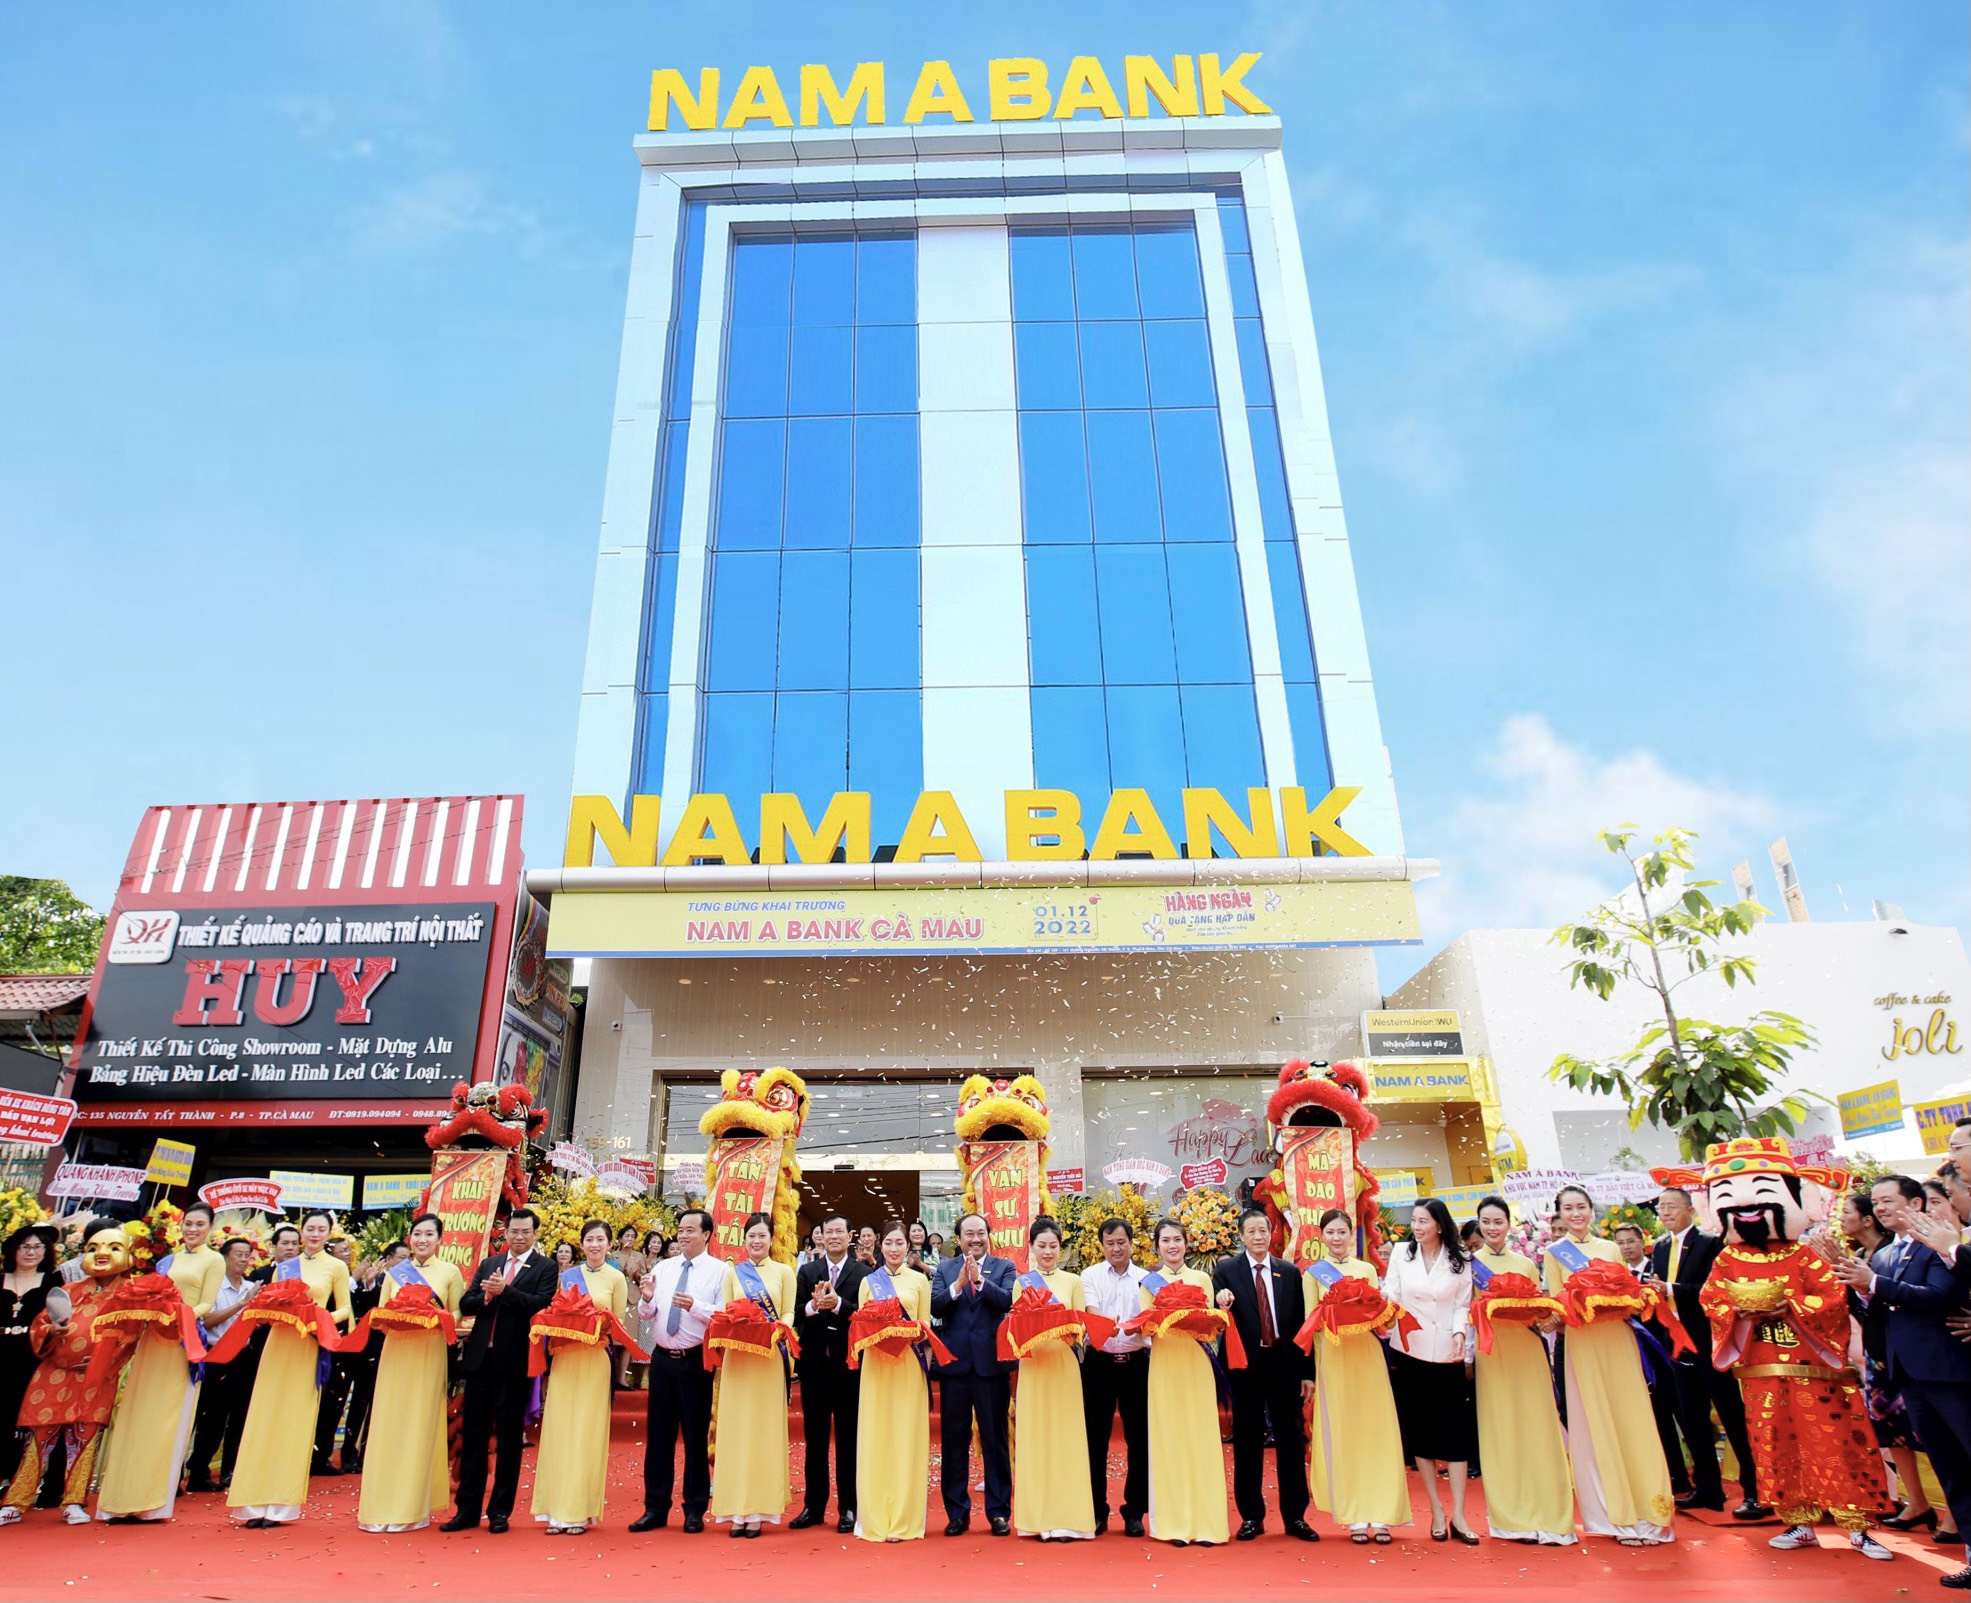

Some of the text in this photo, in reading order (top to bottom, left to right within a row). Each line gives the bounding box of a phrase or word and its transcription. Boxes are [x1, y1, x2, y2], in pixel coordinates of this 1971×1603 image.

[648, 52, 1274, 131] NAM A BANK
[563, 786, 1376, 867] NAM A BANK
[724, 899, 758, 912] BỪNG
[761, 902, 792, 911] KHAI
[795, 900, 845, 911] TRƯƠNG
[1034, 905, 1088, 917] 01.12
[1165, 891, 1207, 912] HÀNG
[177, 912, 484, 948] THIẾT KẾ QUẢNG CÁO VÀ TRANG TRÍ NỘI THẤT
[686, 912, 983, 942] NAM A BANK CÀ MAU
[1034, 919, 1092, 934] 2022
[172, 956, 396, 1026] HUY
[1873, 990, 1951, 1010] coffee & cake
[1881, 1008, 1963, 1061] joli
[97, 1036, 138, 1057] Thiết
[140, 1037, 167, 1057] Kế
[167, 1039, 193, 1057] Thi
[198, 1038, 239, 1060] Công
[242, 1037, 321, 1056] Showroom
[338, 1037, 370, 1058] Mặt
[375, 1037, 417, 1058] Dựng
[423, 1036, 453, 1054] Alu
[88, 1064, 129, 1086] Bảng
[131, 1065, 170, 1086] Hiệu
[172, 1064, 204, 1082] Đèn
[206, 1065, 240, 1082] Led
[250, 1064, 286, 1082] Màn
[289, 1063, 329, 1081] Hình
[333, 1063, 365, 1080] Led
[370, 1062, 400, 1080] Các
[1375, 1076, 1411, 1087] NAM
[1427, 1075, 1467, 1086] BANK
[107, 1108, 149, 1119] NGUYỄN
[154, 1108, 175, 1119] TẤT
[179, 1109, 216, 1119] THÀNH
[289, 1111, 315, 1119] MAU
[1168, 1120, 1230, 1160] Happy
[728, 1154, 762, 1182] TẤN
[1307, 1150, 1330, 1172] MÃ
[113, 1166, 147, 1185] IPHONE
[987, 1168, 1022, 1191] VẠN
[1506, 1171, 1532, 1180] NAM
[1546, 1169, 1580, 1180] BANK
[1528, 1181, 1541, 1190] NAM
[451, 1181, 484, 1200] KHAI
[1306, 1179, 1336, 1200] ĐÁO
[723, 1189, 754, 1215] TÀI
[994, 1197, 1018, 1220] SỰ
